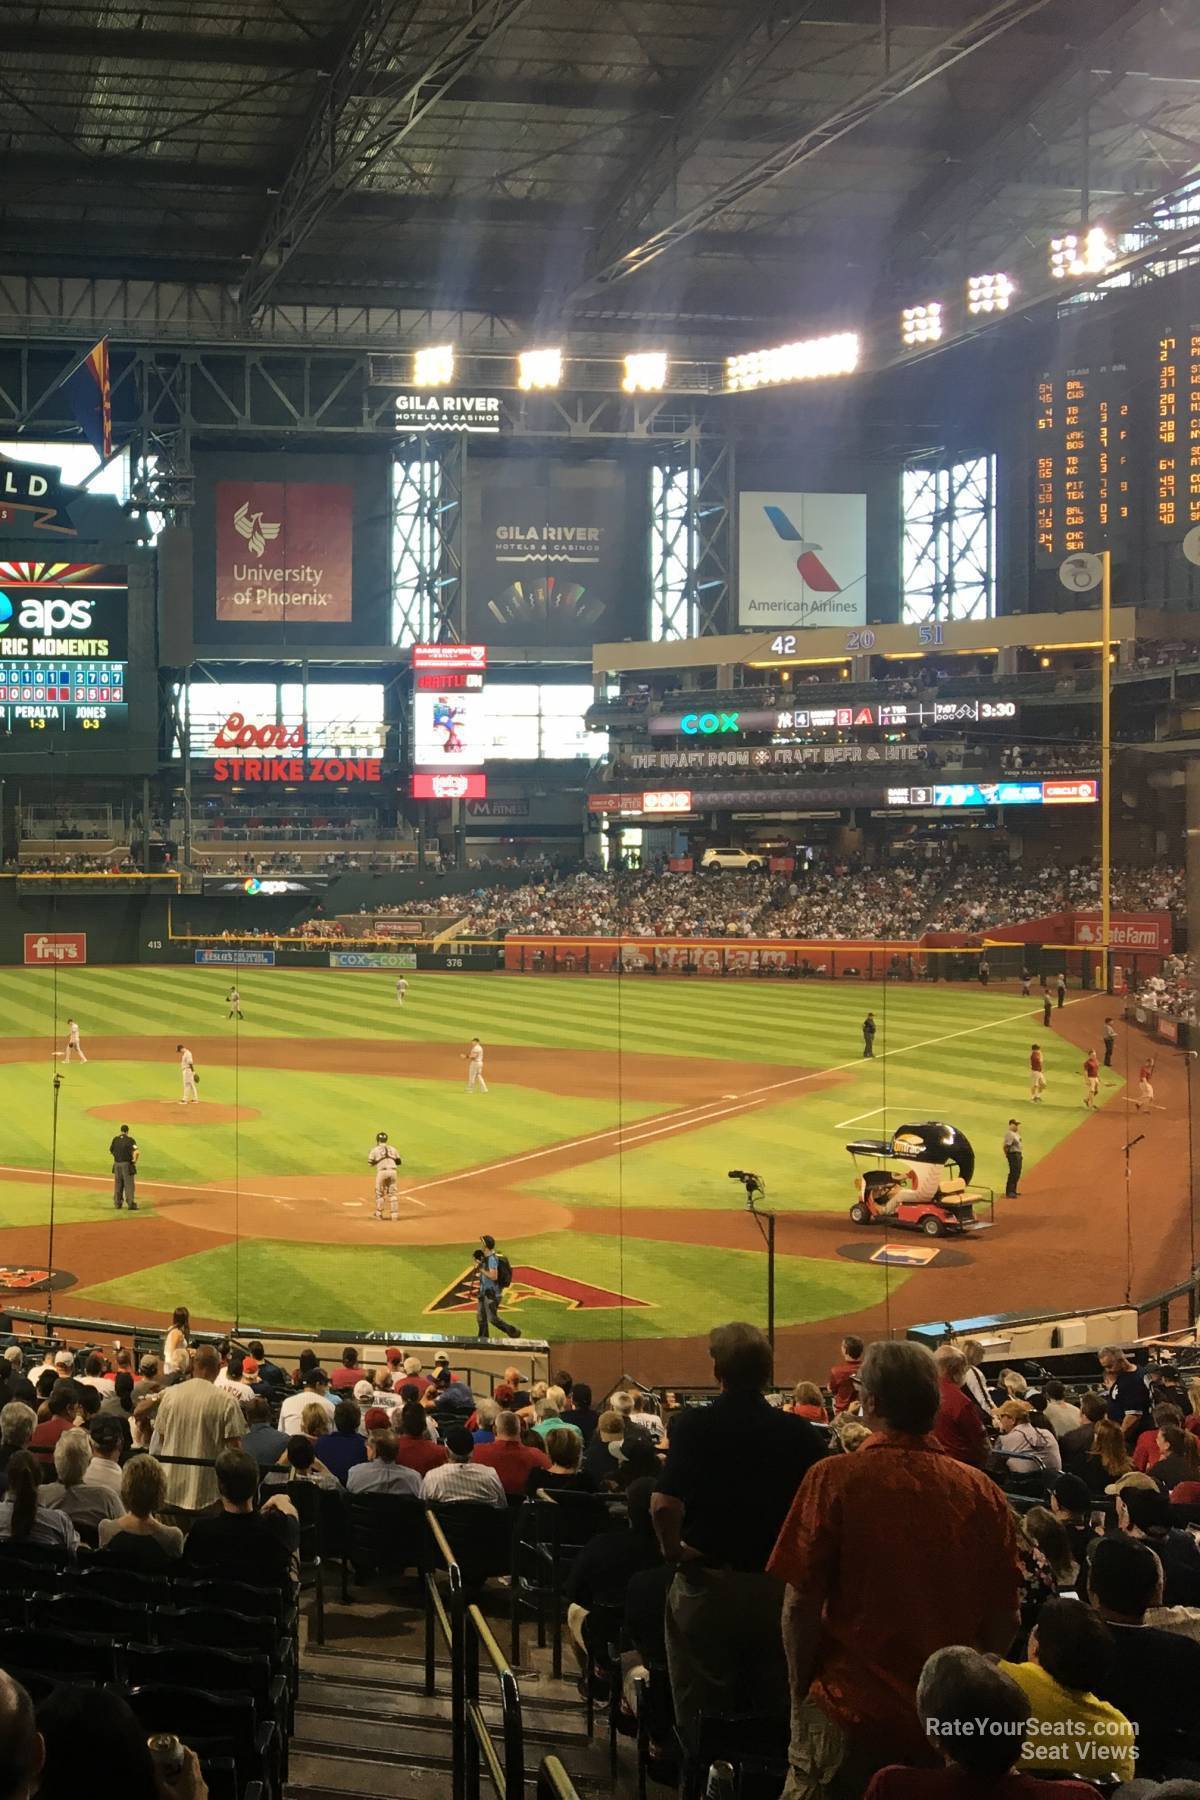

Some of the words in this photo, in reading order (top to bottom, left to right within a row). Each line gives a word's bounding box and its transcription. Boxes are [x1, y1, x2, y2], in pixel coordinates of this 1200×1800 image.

[1160, 338, 1175, 349] 47
[1066, 381, 1084, 390] BAL
[396, 395, 440, 411] GILA
[443, 396, 500, 411] RIVER
[1160, 394, 1175, 404] 28
[1066, 407, 1079, 415] TB
[396, 413, 437, 421] HOTELS
[453, 414, 500, 422] CASINOS
[1160, 421, 1175, 431] 28
[1066, 441, 1084, 450] BOS
[1066, 457, 1078, 465] TB
[1160, 459, 1175, 470] 64
[1066, 481, 1084, 490] PIT
[1066, 507, 1084, 515] BAL
[495, 526, 539, 540] GILA
[543, 527, 599, 541] RIVER
[1066, 532, 1084, 540] CHC
[496, 543, 536, 551] HOTELS
[1066, 542, 1084, 550] SEA
[233, 564, 323, 587] University
[233, 588, 253, 605] of
[256, 588, 328, 606] Phoenix
[748, 599, 809, 611] American
[810, 600, 858, 613] Airlines
[18, 599, 92, 637] aps
[846, 630, 875, 650] 20
[918, 624, 944, 645] 51
[32, 638, 109, 657] MOMENTS
[770, 635, 796, 655] 42
[15, 706, 59, 719] PERALTA
[75, 706, 106, 719] JONES
[982, 703, 1016, 718] 3:30
[29, 719, 45, 729] 1-3
[83, 719, 99, 729] 0-3
[680, 713, 740, 735] COX
[214, 712, 305, 749] Coors
[630, 754, 657, 769] THE
[660, 752, 705, 767] DRAFT
[708, 751, 750, 765] ROOM
[774, 749, 821, 763] CRAFT
[824, 747, 862, 762] BEER
[866, 745, 880, 760] &
[885, 744, 928, 760] BITES
[214, 759, 304, 781] STRIKE
[310, 759, 381, 781] ZONE
[916, 790, 926, 801] 3
[1096, 927, 1127, 943] Sate
[1126, 928, 1156, 944] Farm
[32, 936, 78, 960] fry's
[147, 940, 162, 949] 413
[340, 954, 365, 966] COX
[379, 955, 406, 966] COX
[446, 958, 463, 967] 376
[655, 945, 719, 968] State
[724, 947, 787, 967] Farm
